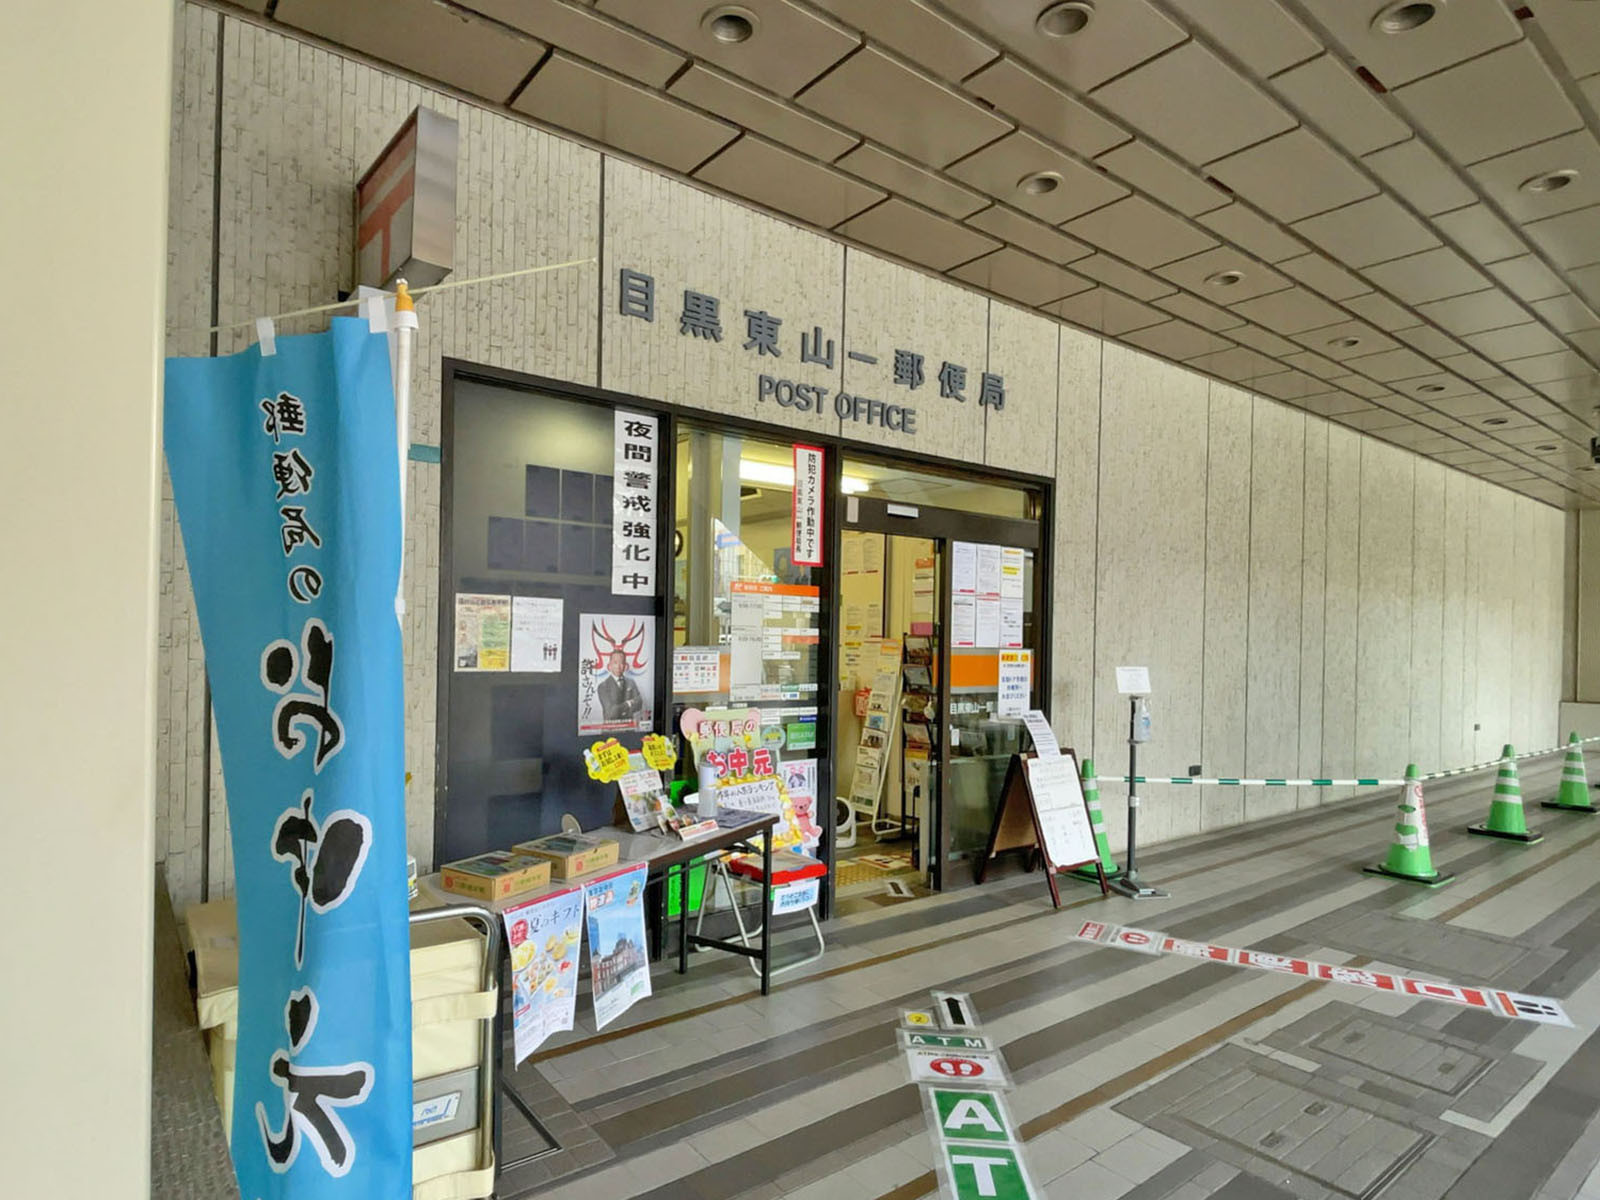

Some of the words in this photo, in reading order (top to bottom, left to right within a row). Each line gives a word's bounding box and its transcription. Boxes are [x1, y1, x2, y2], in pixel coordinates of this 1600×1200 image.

[619, 267, 1006, 411] 目黒東山一郵便局
[758, 374, 829, 414] POST
[834, 391, 918, 435] OFFICE
[621, 419, 653, 591] 夜間警戒強化中
[806, 452, 817, 559] 防犯カメラ作動中です
[706, 746, 774, 779] お中元
